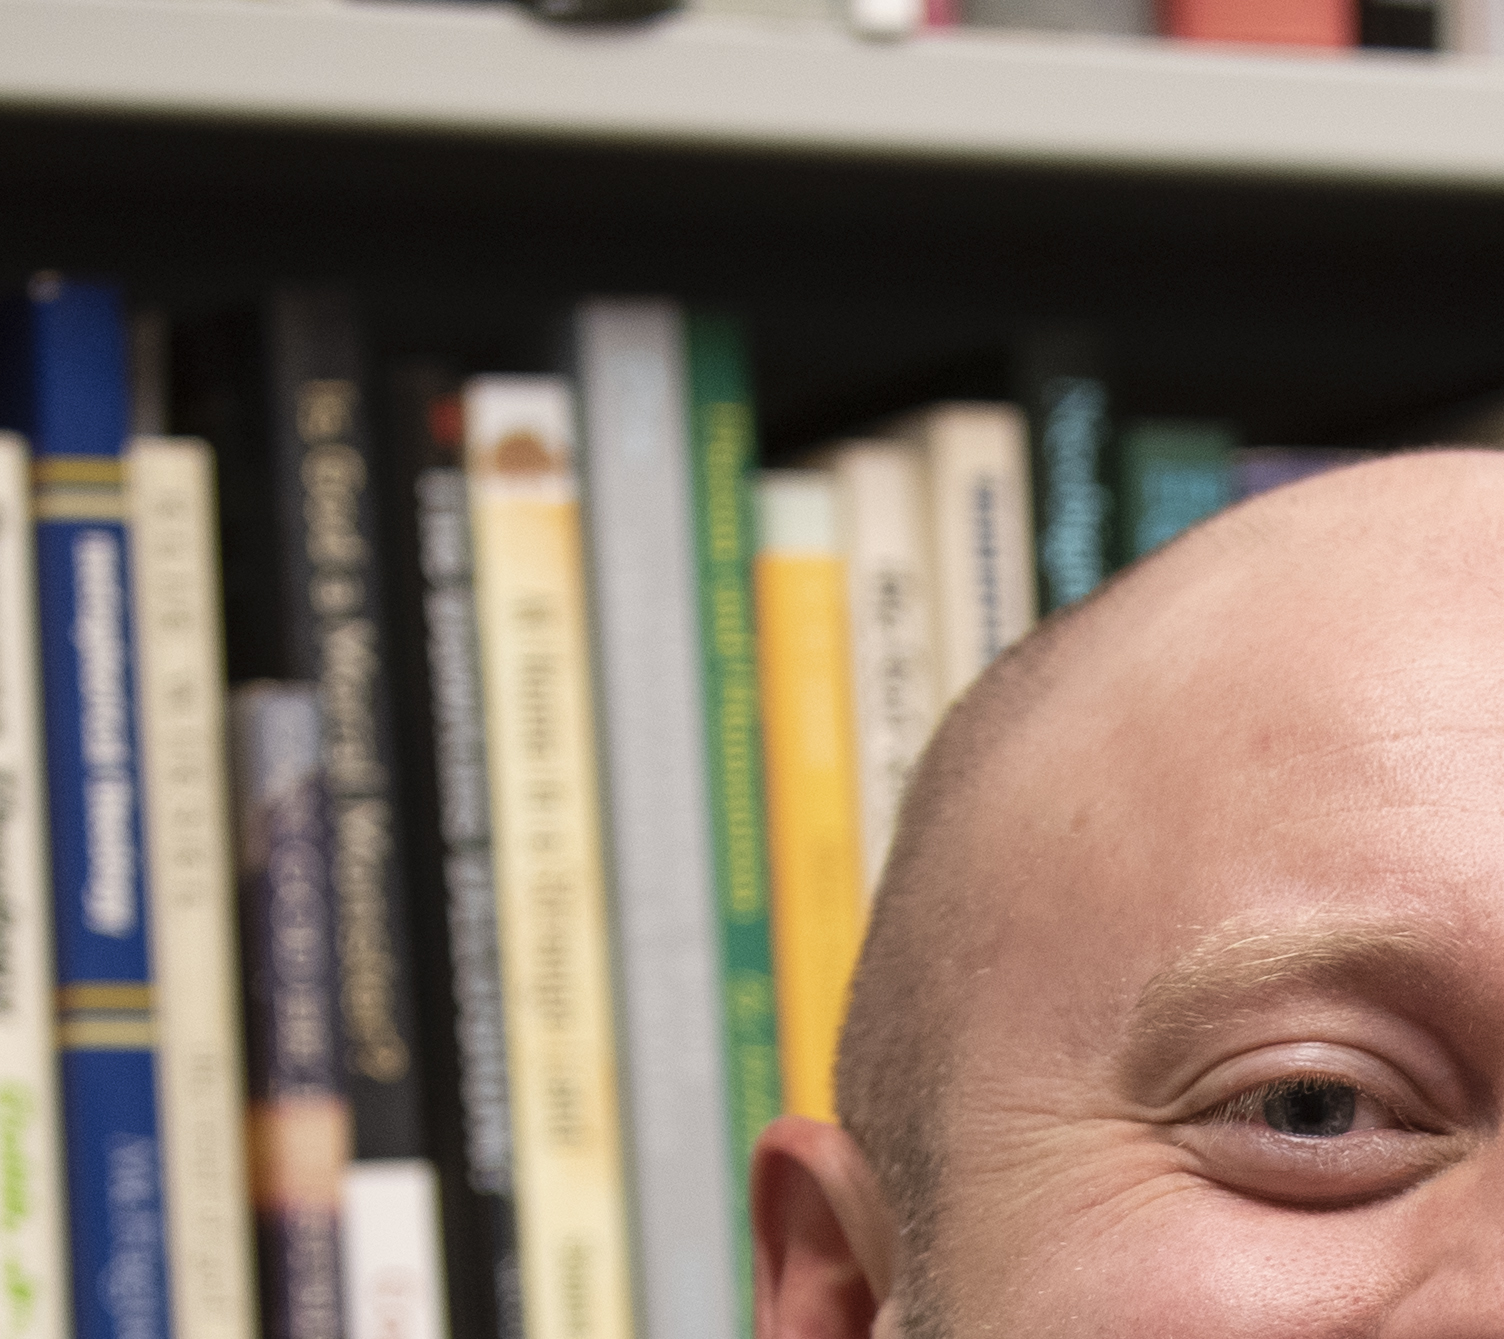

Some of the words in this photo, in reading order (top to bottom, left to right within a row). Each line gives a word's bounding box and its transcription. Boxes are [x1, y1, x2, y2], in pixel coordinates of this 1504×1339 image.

[304, 447, 366, 568] God
[322, 622, 388, 792] Moral
[334, 798, 412, 1082] Monster?
